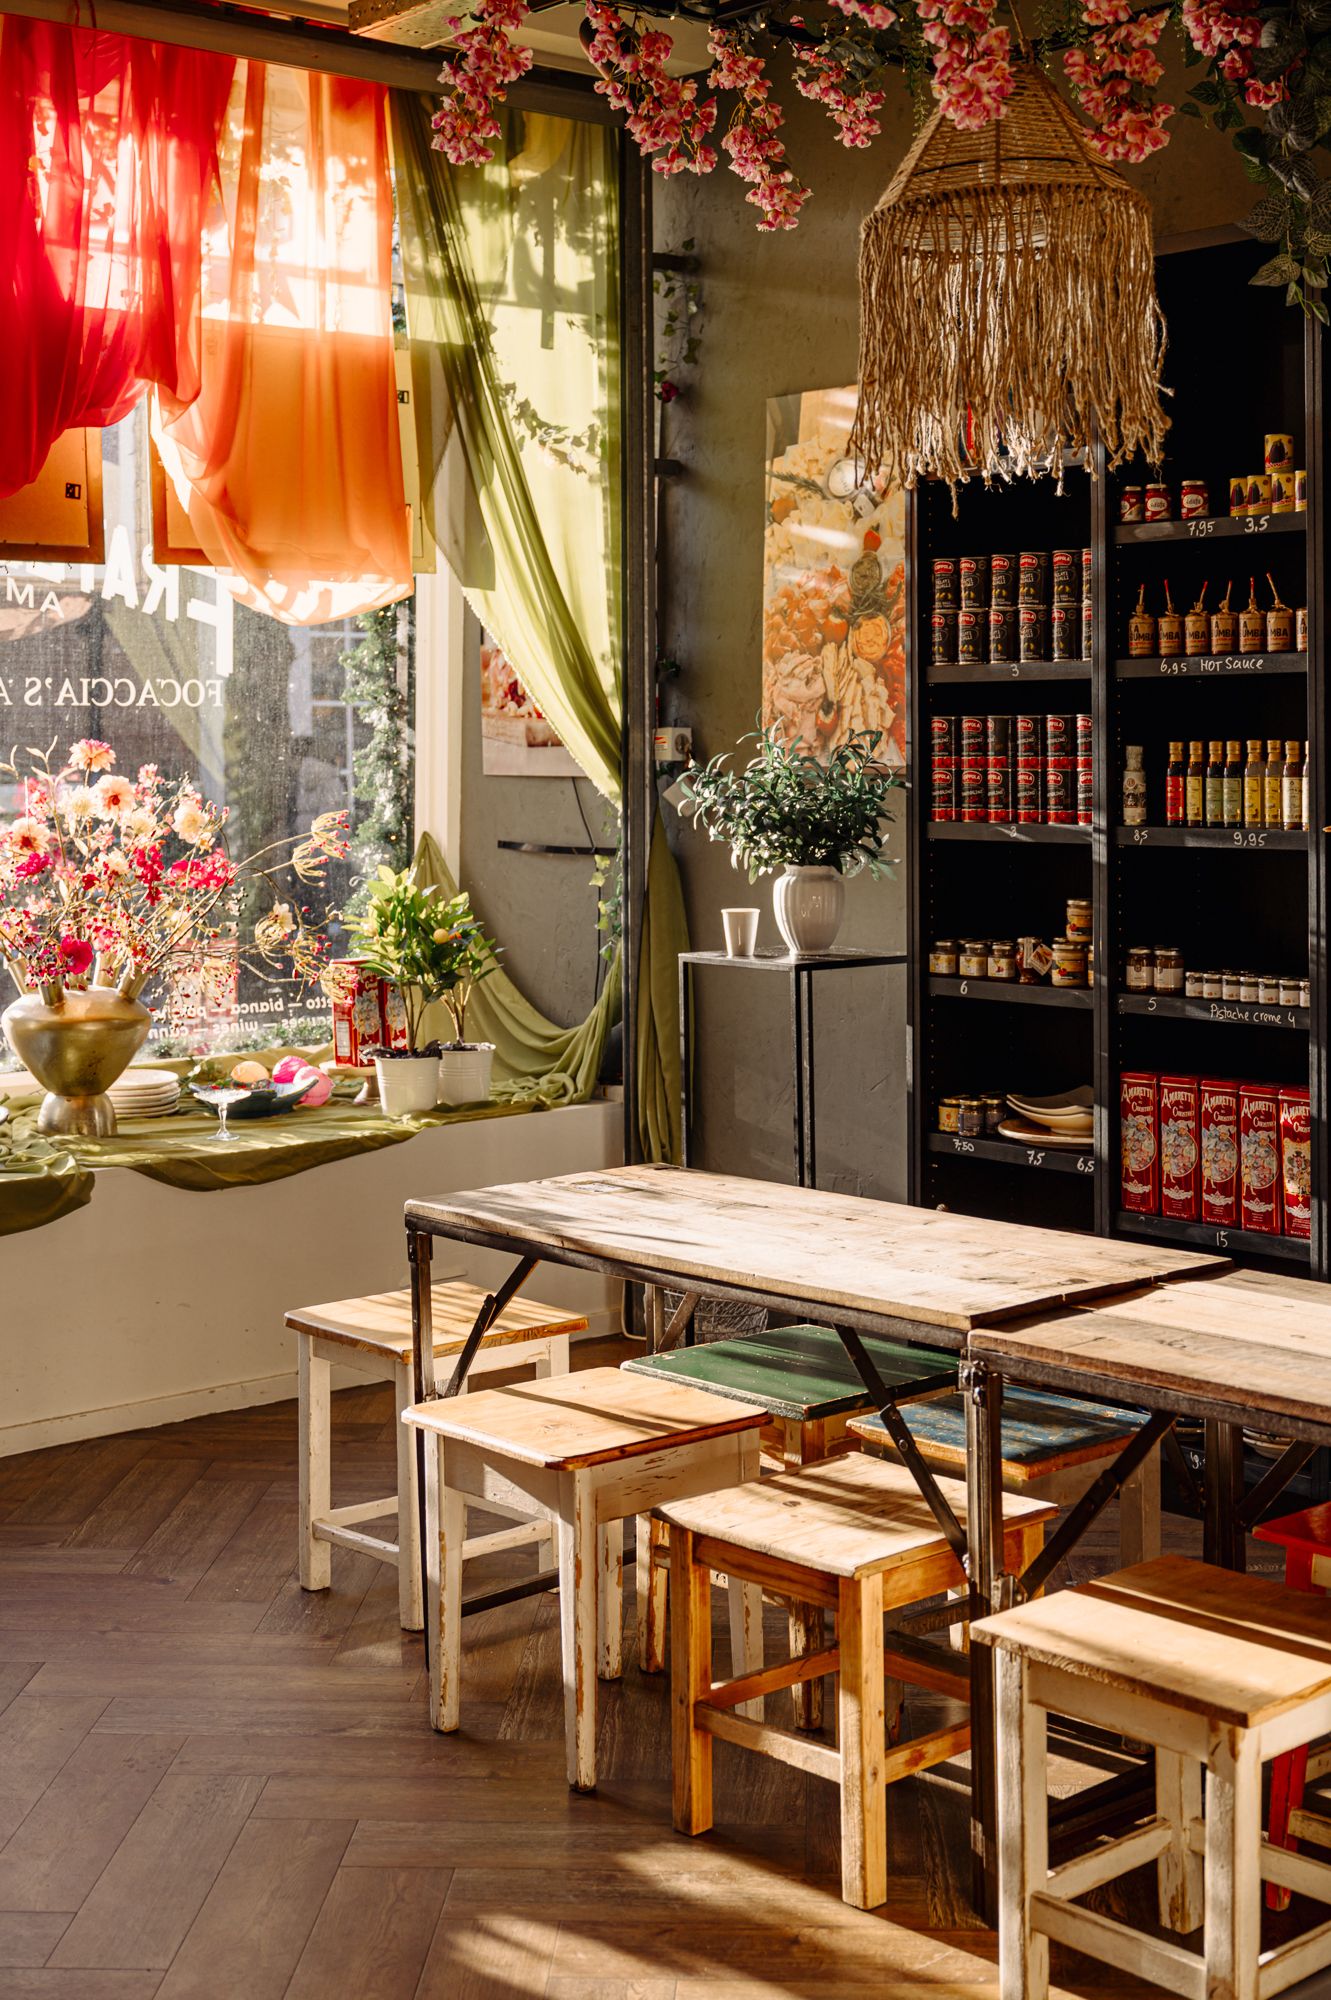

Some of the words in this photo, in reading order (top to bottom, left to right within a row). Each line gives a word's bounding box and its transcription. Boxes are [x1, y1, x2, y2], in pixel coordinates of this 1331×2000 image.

[1187, 521, 1217, 537] 7,95
[1244, 515, 1270, 533] 3,5
[1010, 664, 1020, 677] 3
[1160, 659, 1187, 675] 6,95
[1200, 659, 1222, 672] HOT
[1225, 656, 1264, 670] Sauce
[1233, 831, 1267, 847] 9,95
[960, 980, 968, 995] 6
[1148, 997, 1157, 1011] 5
[1210, 1004, 1249, 1021] Pistache
[1253, 1011, 1282, 1025] creme
[1287, 1011, 1296, 1029] 4
[1027, 1151, 1045, 1166] 7,5
[1077, 1157, 1095, 1172] 6,5
[1215, 1231, 1229, 1248] 15
